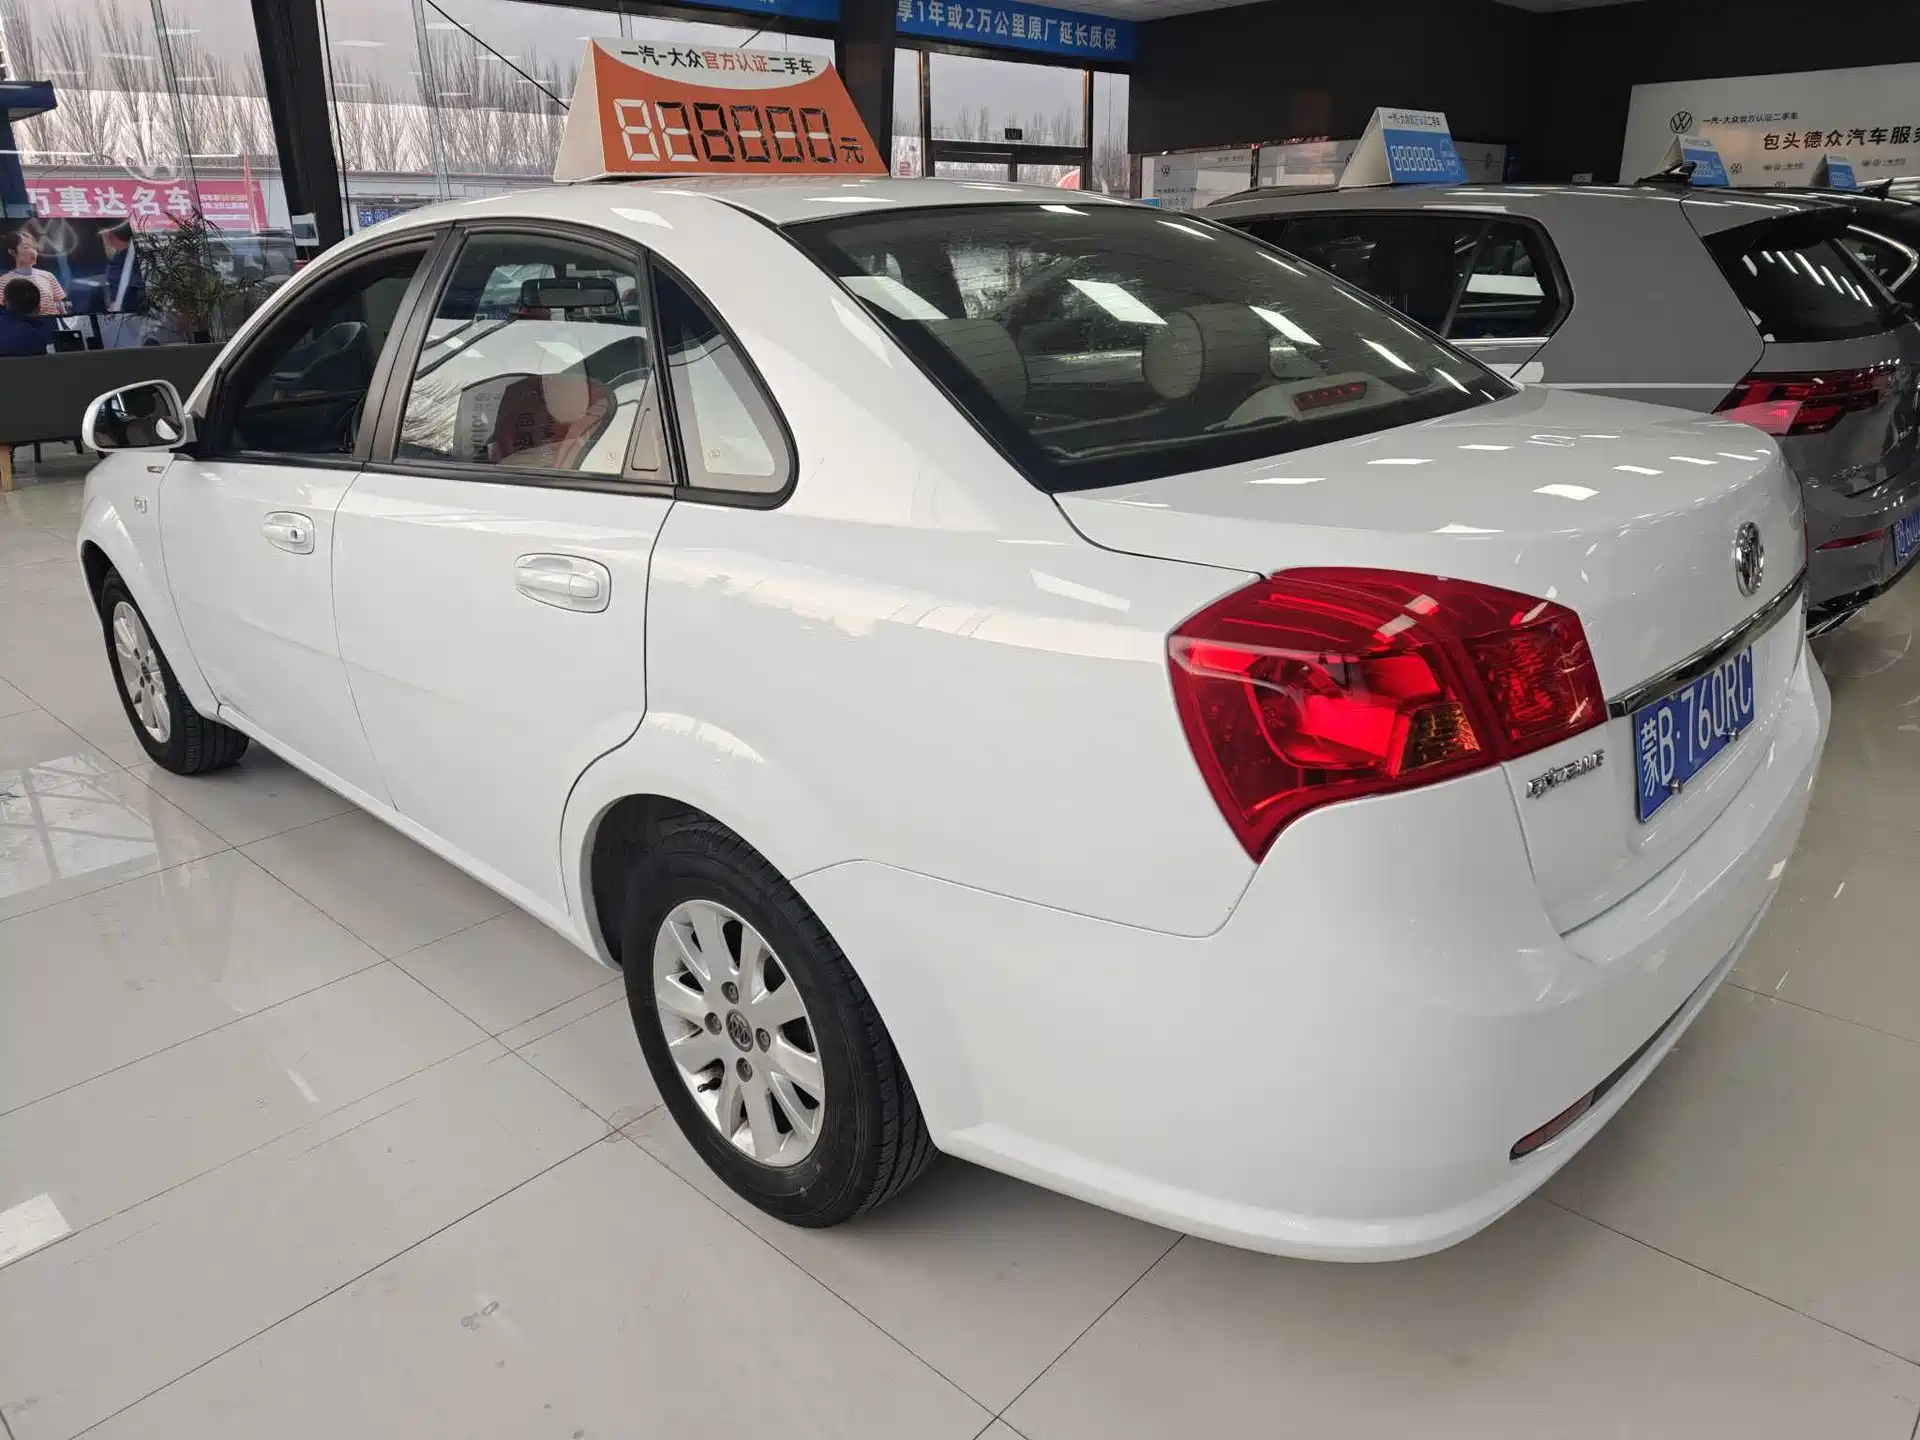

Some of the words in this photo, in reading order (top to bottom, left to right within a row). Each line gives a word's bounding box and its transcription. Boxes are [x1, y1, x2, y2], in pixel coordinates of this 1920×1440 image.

[620, 45, 816, 76] 一汽-大众官方认证二手车
